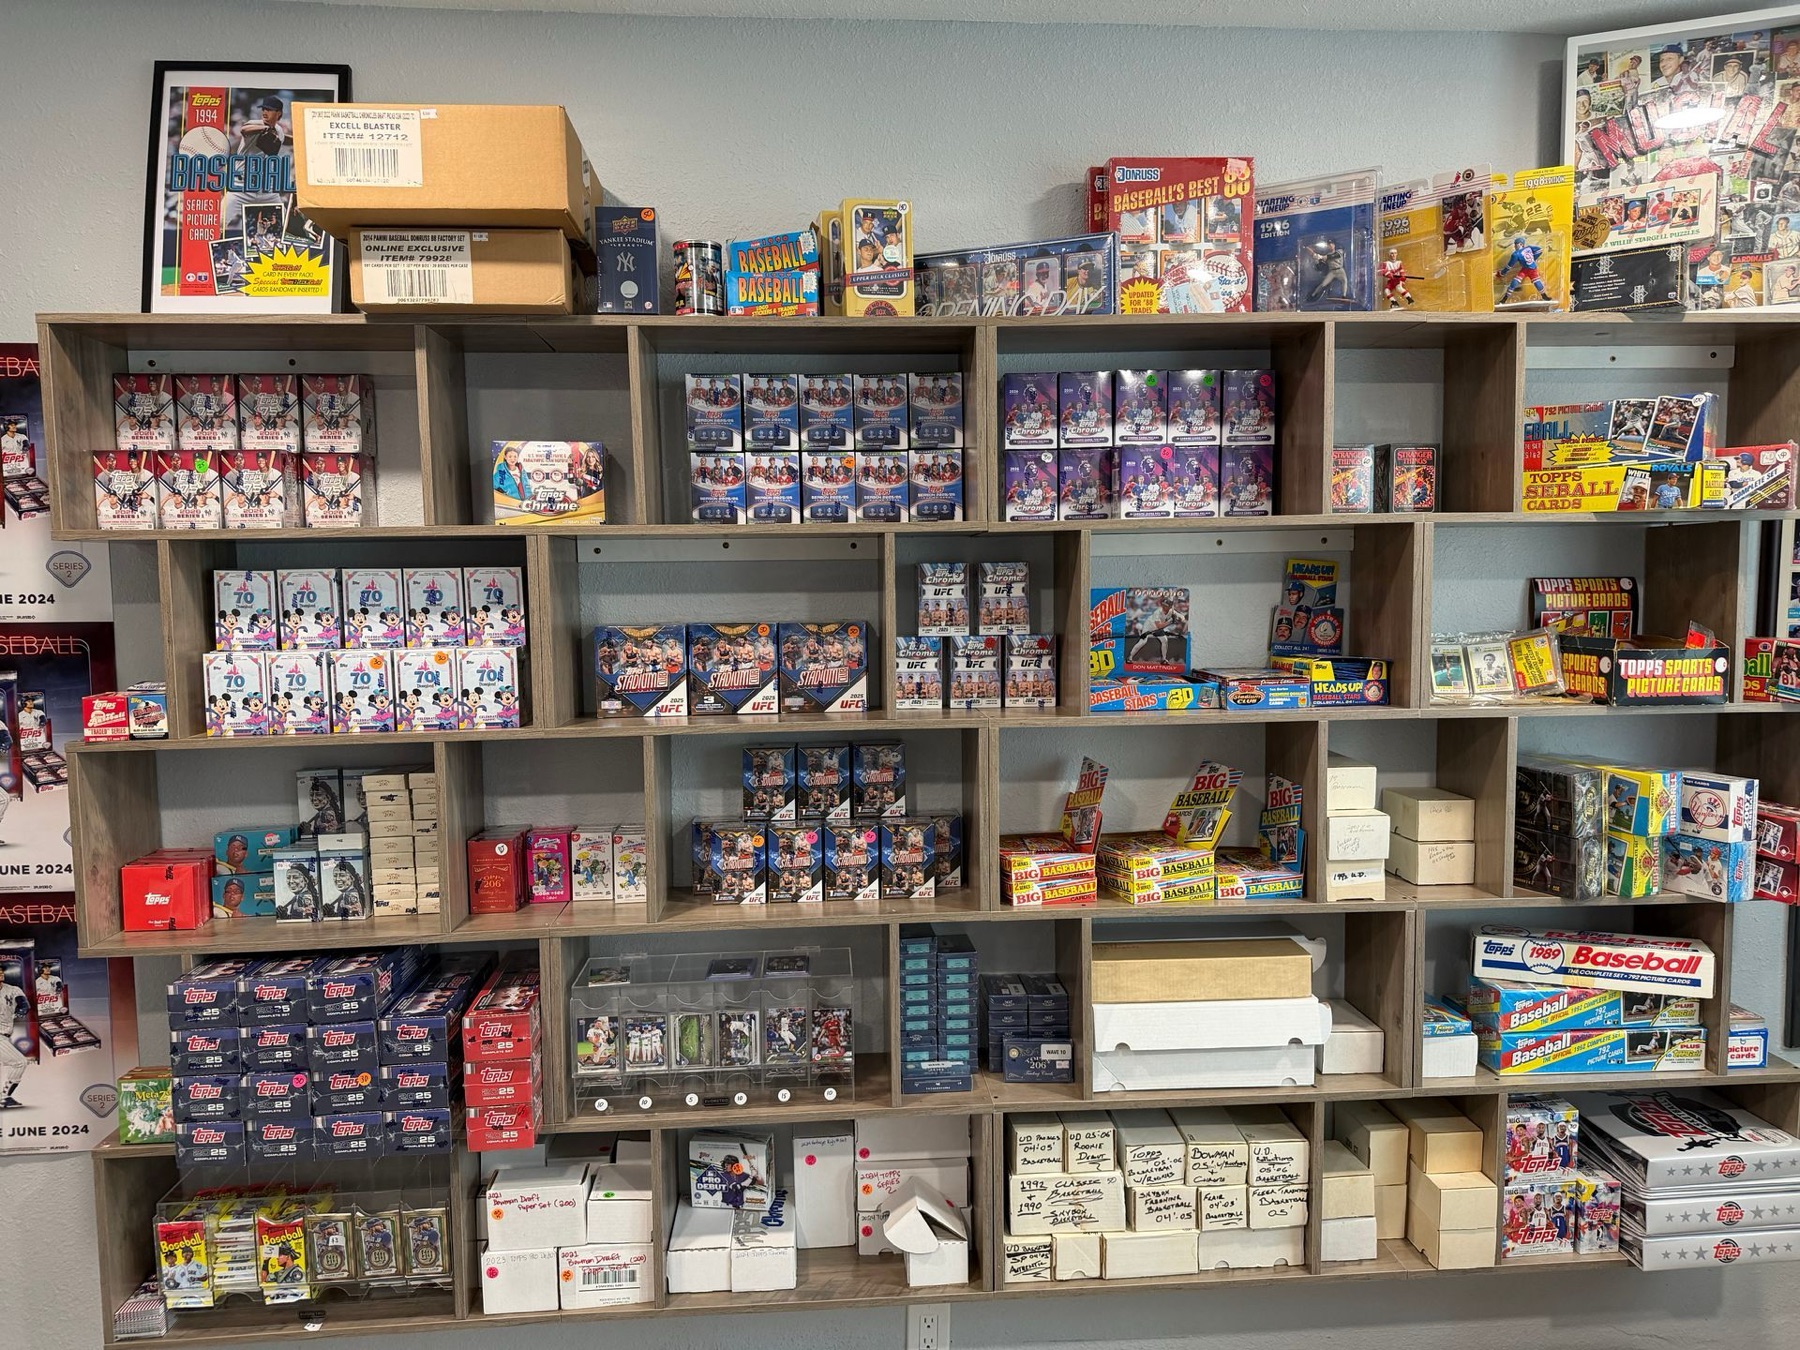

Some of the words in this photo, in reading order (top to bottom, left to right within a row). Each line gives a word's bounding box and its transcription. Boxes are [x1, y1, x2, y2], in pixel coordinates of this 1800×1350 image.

[195, 109, 218, 123] 1994
[330, 122, 360, 130] EXCELL
[364, 122, 400, 130] BLASTER
[323, 132, 364, 140] ITEM#
[369, 134, 409, 142] 12712
[1524, 176, 1544, 188] 1998
[1114, 182, 1185, 212] BASEBALL'S
[1188, 176, 1220, 199] BEST
[1526, 204, 1542, 217] 22
[186, 214, 218, 226] PICTURE
[189, 229, 214, 241] CARDS
[1260, 230, 1290, 238] EDITION
[599, 237, 623, 245] YANKEE
[625, 236, 654, 246] STADIUM
[738, 240, 806, 272] BASEBALL
[1731, 253, 1777, 264] CARDINALS
[738, 278, 806, 304] BASEBALL
[1041, 286, 1106, 316] DAY
[1544, 406, 1556, 416] 792
[1558, 404, 1583, 415] PICTURE
[1397, 451, 1432, 460] STRANGER
[1651, 463, 1692, 473] ROYALS
[1530, 472, 1582, 484] TOPPS
[1733, 477, 1764, 500] COMPLETE
[1765, 468, 1778, 480] SET
[1527, 499, 1582, 511] CARDS
[52, 562, 84, 570] SERIES
[1536, 578, 1572, 592] TOPPS
[1574, 579, 1620, 592] SPORTS
[934, 588, 954, 596] UFC
[18, 594, 56, 604] 2024
[1546, 593, 1592, 609] PICTURE
[1592, 592, 1630, 608] CARDS
[907, 661, 927, 669] UFC
[1563, 652, 1599, 674] SPORTS
[1618, 659, 1665, 678] TOPPS
[1664, 658, 1714, 677] SPORTS
[615, 674, 658, 692] STADIUM
[708, 672, 750, 690] STADIUM
[1627, 677, 1681, 697] PICTURE
[1682, 676, 1724, 695] CARDS
[1313, 683, 1344, 694] HEADS
[1344, 682, 1364, 694] UP!
[1090, 685, 1140, 705] BASEBALL
[1124, 695, 1157, 710] STARS
[1166, 687, 1194, 710] 3D
[659, 703, 683, 713] UFC
[752, 701, 775, 712] UFC
[1192, 773, 1228, 792] BIG
[1068, 788, 1102, 808] BASEBALL
[1176, 789, 1232, 808] BASEBALL
[1270, 788, 1293, 808] BIG
[1262, 806, 1300, 824] BASEBALL
[36, 864, 72, 875] 2024
[1014, 868, 1039, 880] BIG
[1042, 860, 1094, 877] BASEBALL
[1136, 868, 1161, 880] BIG
[1163, 857, 1214, 875] BASEBALL
[483, 879, 502, 888] 206
[1220, 886, 1246, 898] BIG
[1248, 880, 1302, 895] BASEBALL
[806, 894, 820, 902] UFC
[1016, 892, 1042, 904] BIG
[1044, 882, 1096, 899] BASEBALL
[1137, 892, 1162, 904] BIG
[1164, 882, 1214, 899] BASEBALL
[1529, 946, 1562, 960] 1989
[1572, 946, 1702, 975] Baseball
[1580, 969, 1612, 978] COMPLETE
[1640, 975, 1670, 984] PICTURE
[1510, 994, 1568, 1029] Baseball
[1540, 1016, 1550, 1026] THE
[1550, 1010, 1570, 1022] OFFICIAL
[1571, 1004, 1582, 1014] 1992
[1584, 996, 1606, 1010] COMPLETE
[1584, 1013, 1604, 1026] PICTURE
[1604, 1008, 1620, 1018] CARDS
[1596, 1006, 1606, 1016] 792
[1511, 1032, 1570, 1066] Baseball
[1598, 1045, 1610, 1055] 792
[1587, 1052, 1608, 1066] PICTURE
[1608, 1048, 1624, 1059] CARDS
[1730, 1052, 1756, 1060] cards
[1030, 1061, 1047, 1069] 206
[87, 1094, 116, 1102] SERIES
[8, 1126, 47, 1138] JUNE
[52, 1125, 90, 1136] 2024
[1070, 1133, 1081, 1141] UD
[1074, 1142, 1104, 1150] ROOKIE
[1190, 1148, 1235, 1160] BOWMAN
[702, 1176, 721, 1184] PRO
[1020, 1180, 1047, 1190] 1992
[696, 1182, 728, 1192] DEBUT
[493, 1198, 518, 1206] Bowman
[520, 1193, 540, 1202] Draft
[1019, 1202, 1042, 1212] 1990
[262, 1226, 304, 1246] Baseball
[160, 1232, 203, 1254] Baseball
[1006, 1244, 1020, 1252] UD
[567, 1256, 594, 1266] Bowman
[630, 1254, 647, 1264] (200)
